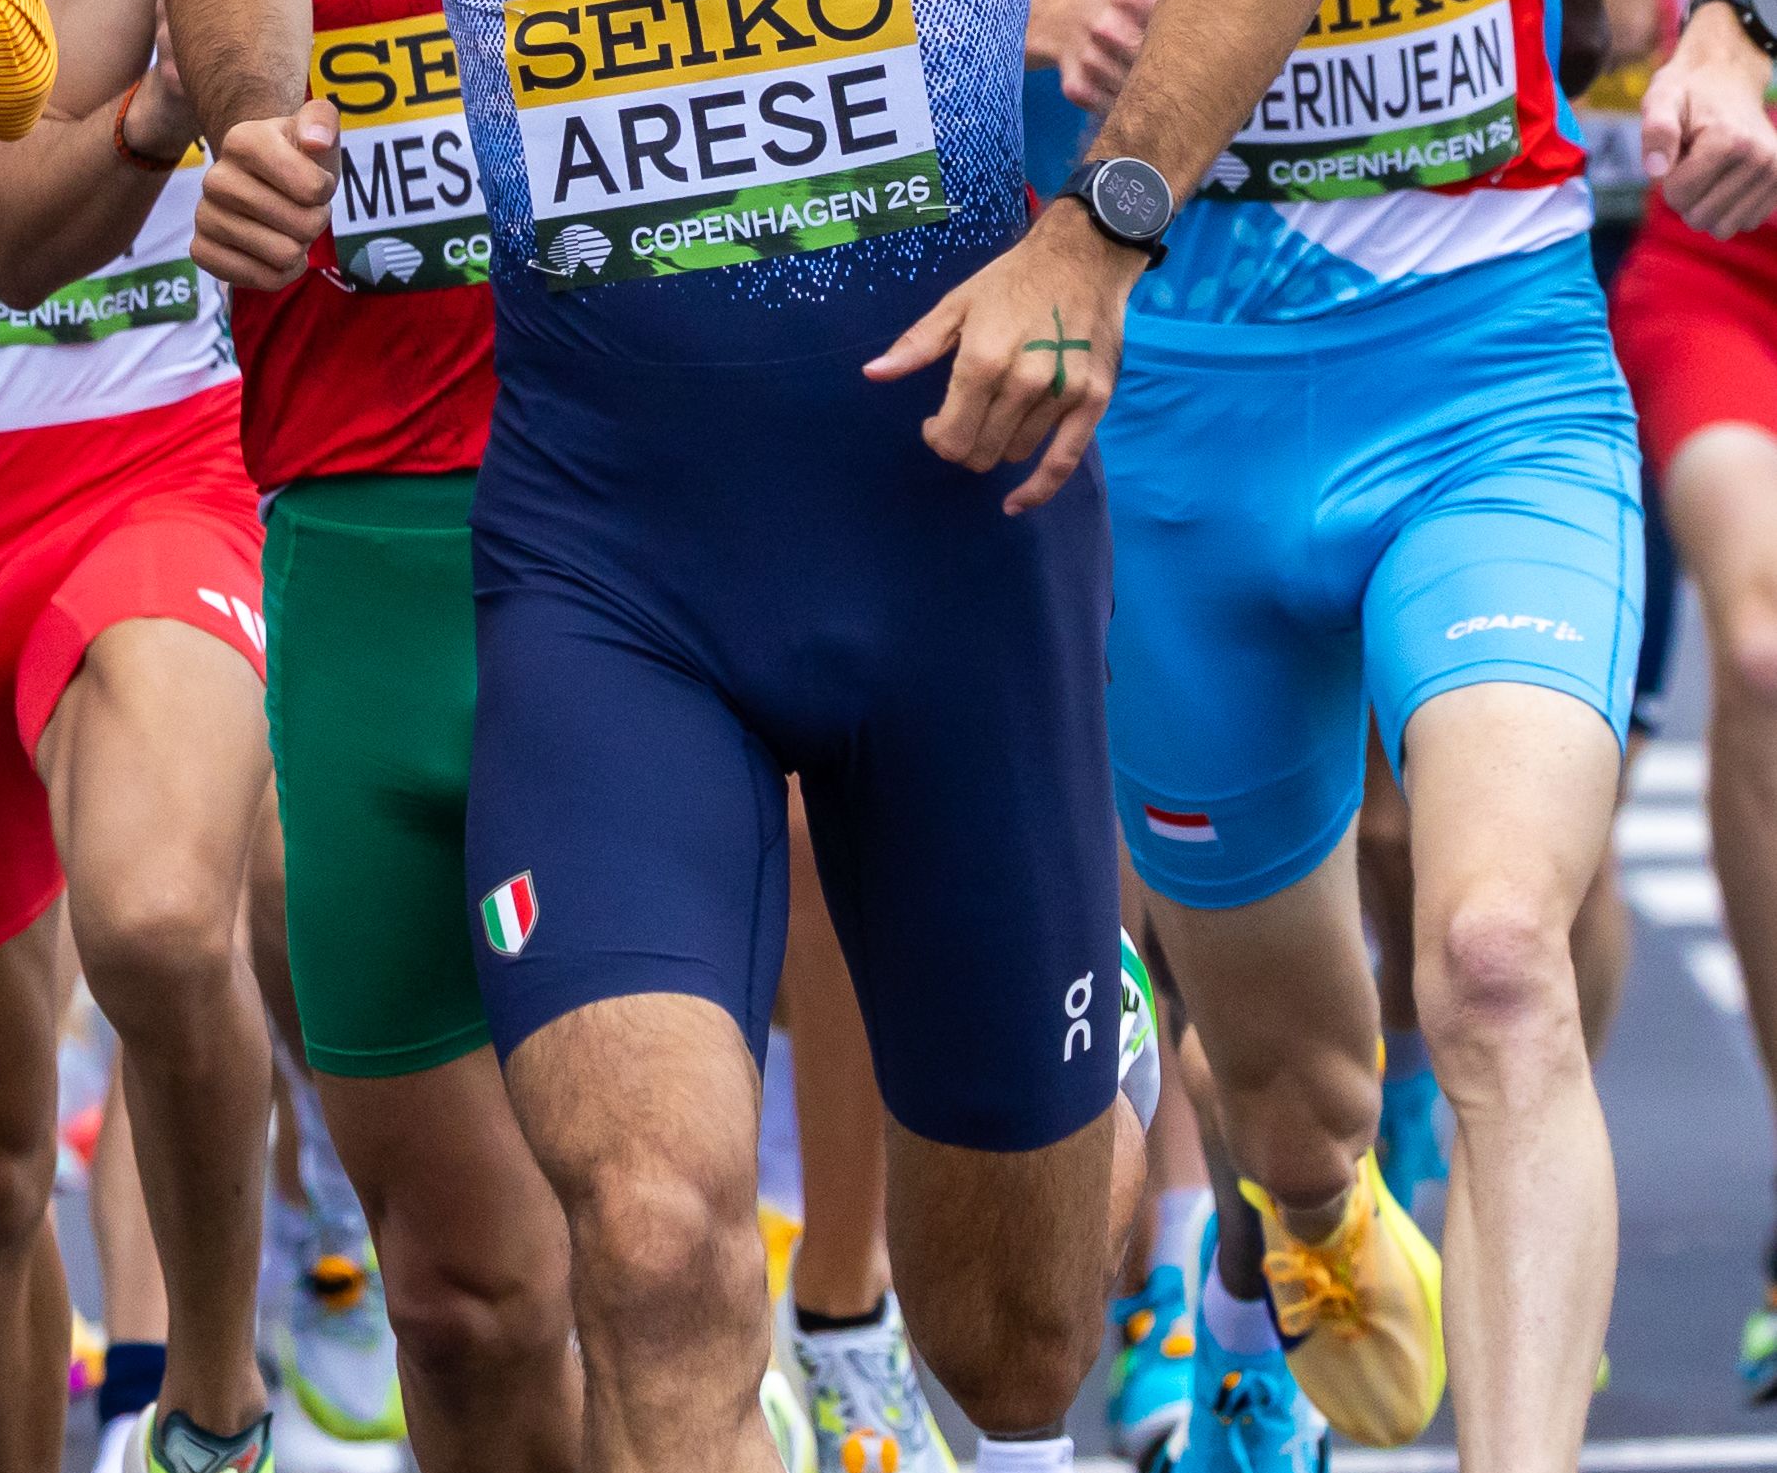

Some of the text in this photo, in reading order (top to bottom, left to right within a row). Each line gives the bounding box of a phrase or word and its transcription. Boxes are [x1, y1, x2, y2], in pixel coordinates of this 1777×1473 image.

[553, 64, 898, 204] ARESE
[1267, 130, 1485, 184] COPENHAGEN
[631, 175, 931, 258] COPENHAGEN 26
[153, 275, 190, 308] 26
[1446, 614, 1555, 640] CRAFT
